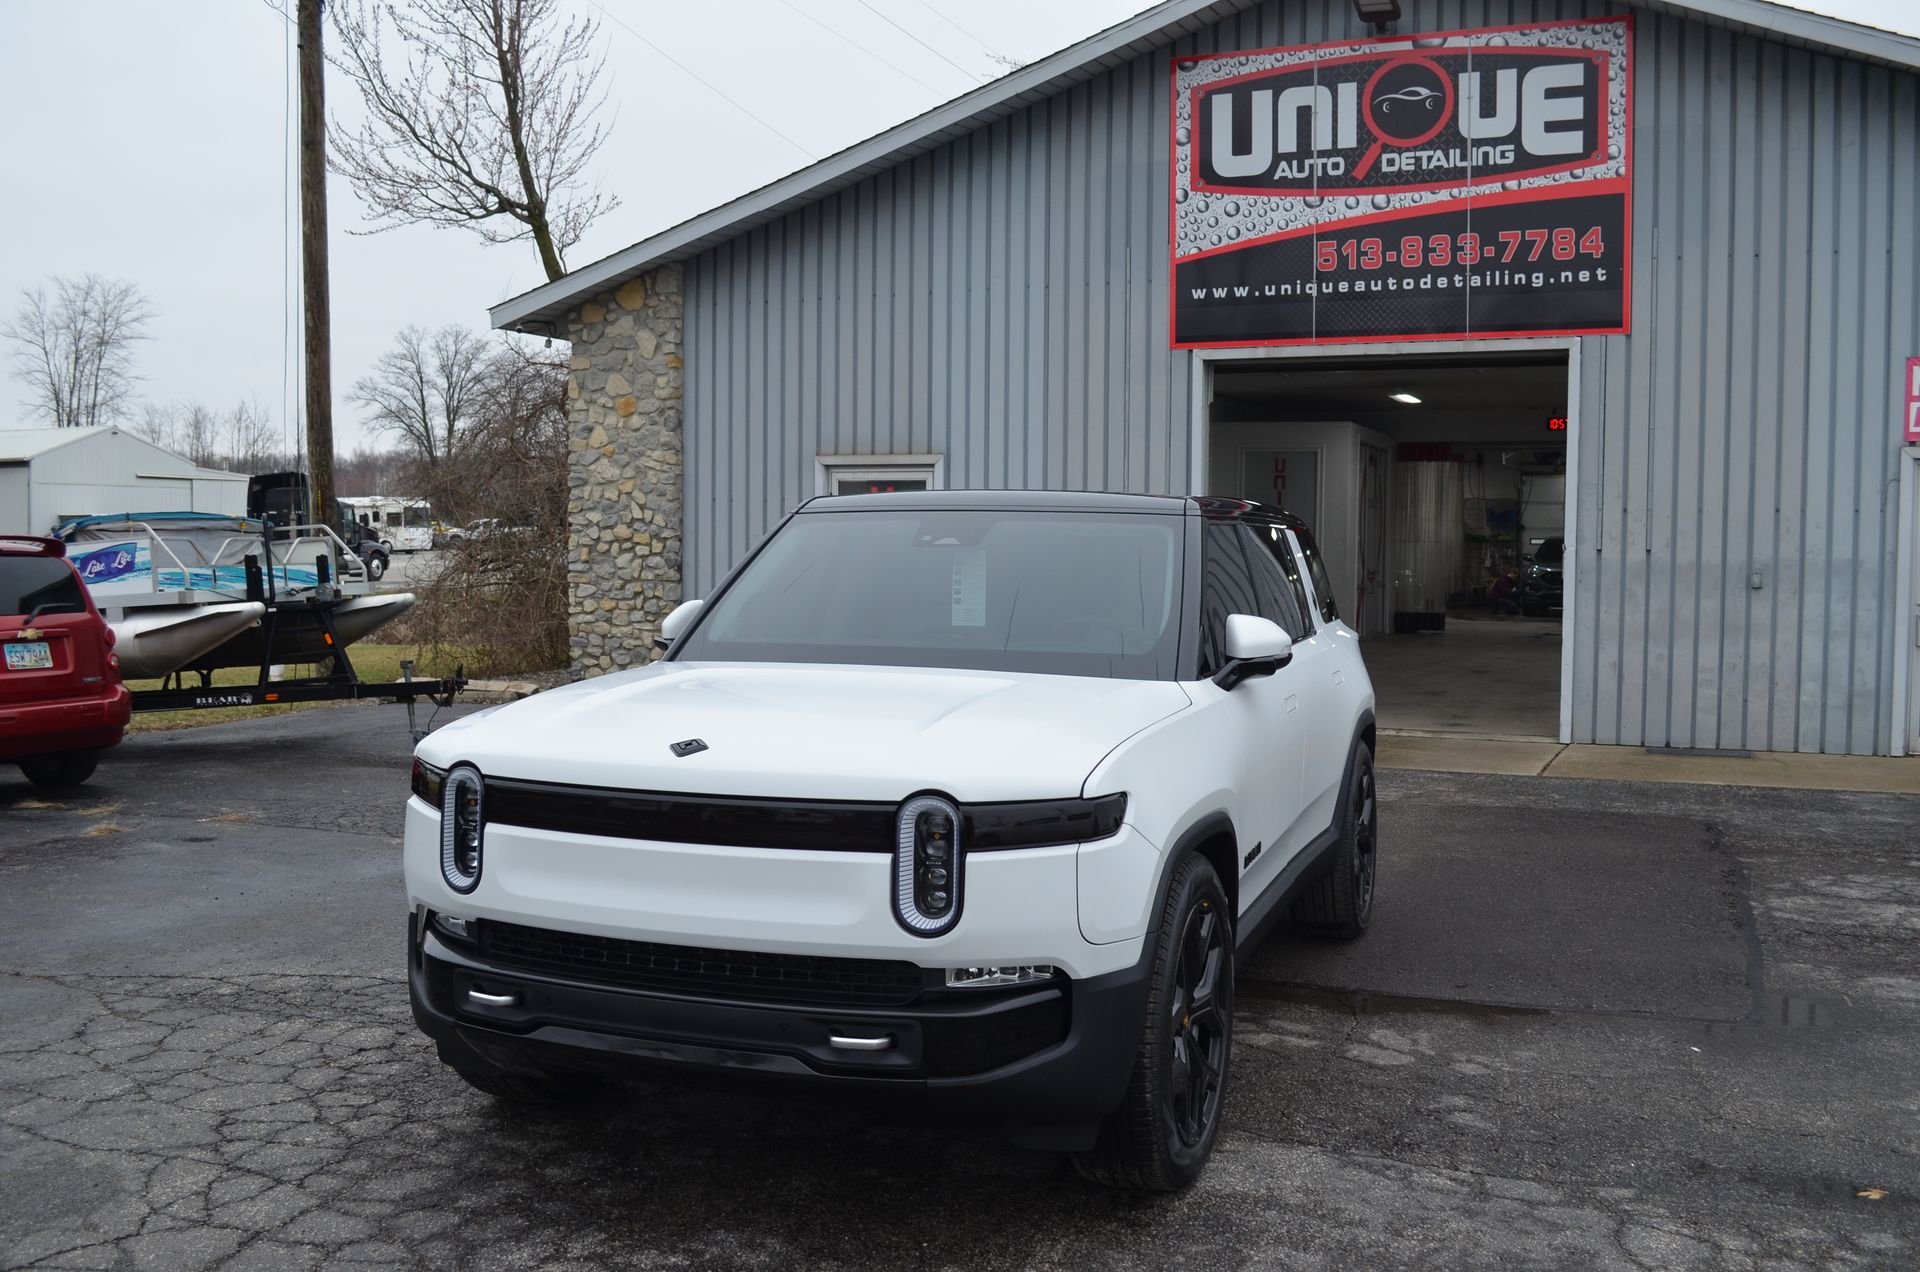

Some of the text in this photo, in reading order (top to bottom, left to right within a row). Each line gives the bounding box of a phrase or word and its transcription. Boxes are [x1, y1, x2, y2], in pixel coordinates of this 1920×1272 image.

[1273, 145, 1515, 180] AUTO DETAILING
[1317, 226, 1605, 271] 513-833-7784
[1191, 267, 1608, 299] www.uniqueautodetailing.net
[82, 550, 132, 578] Lake Life
